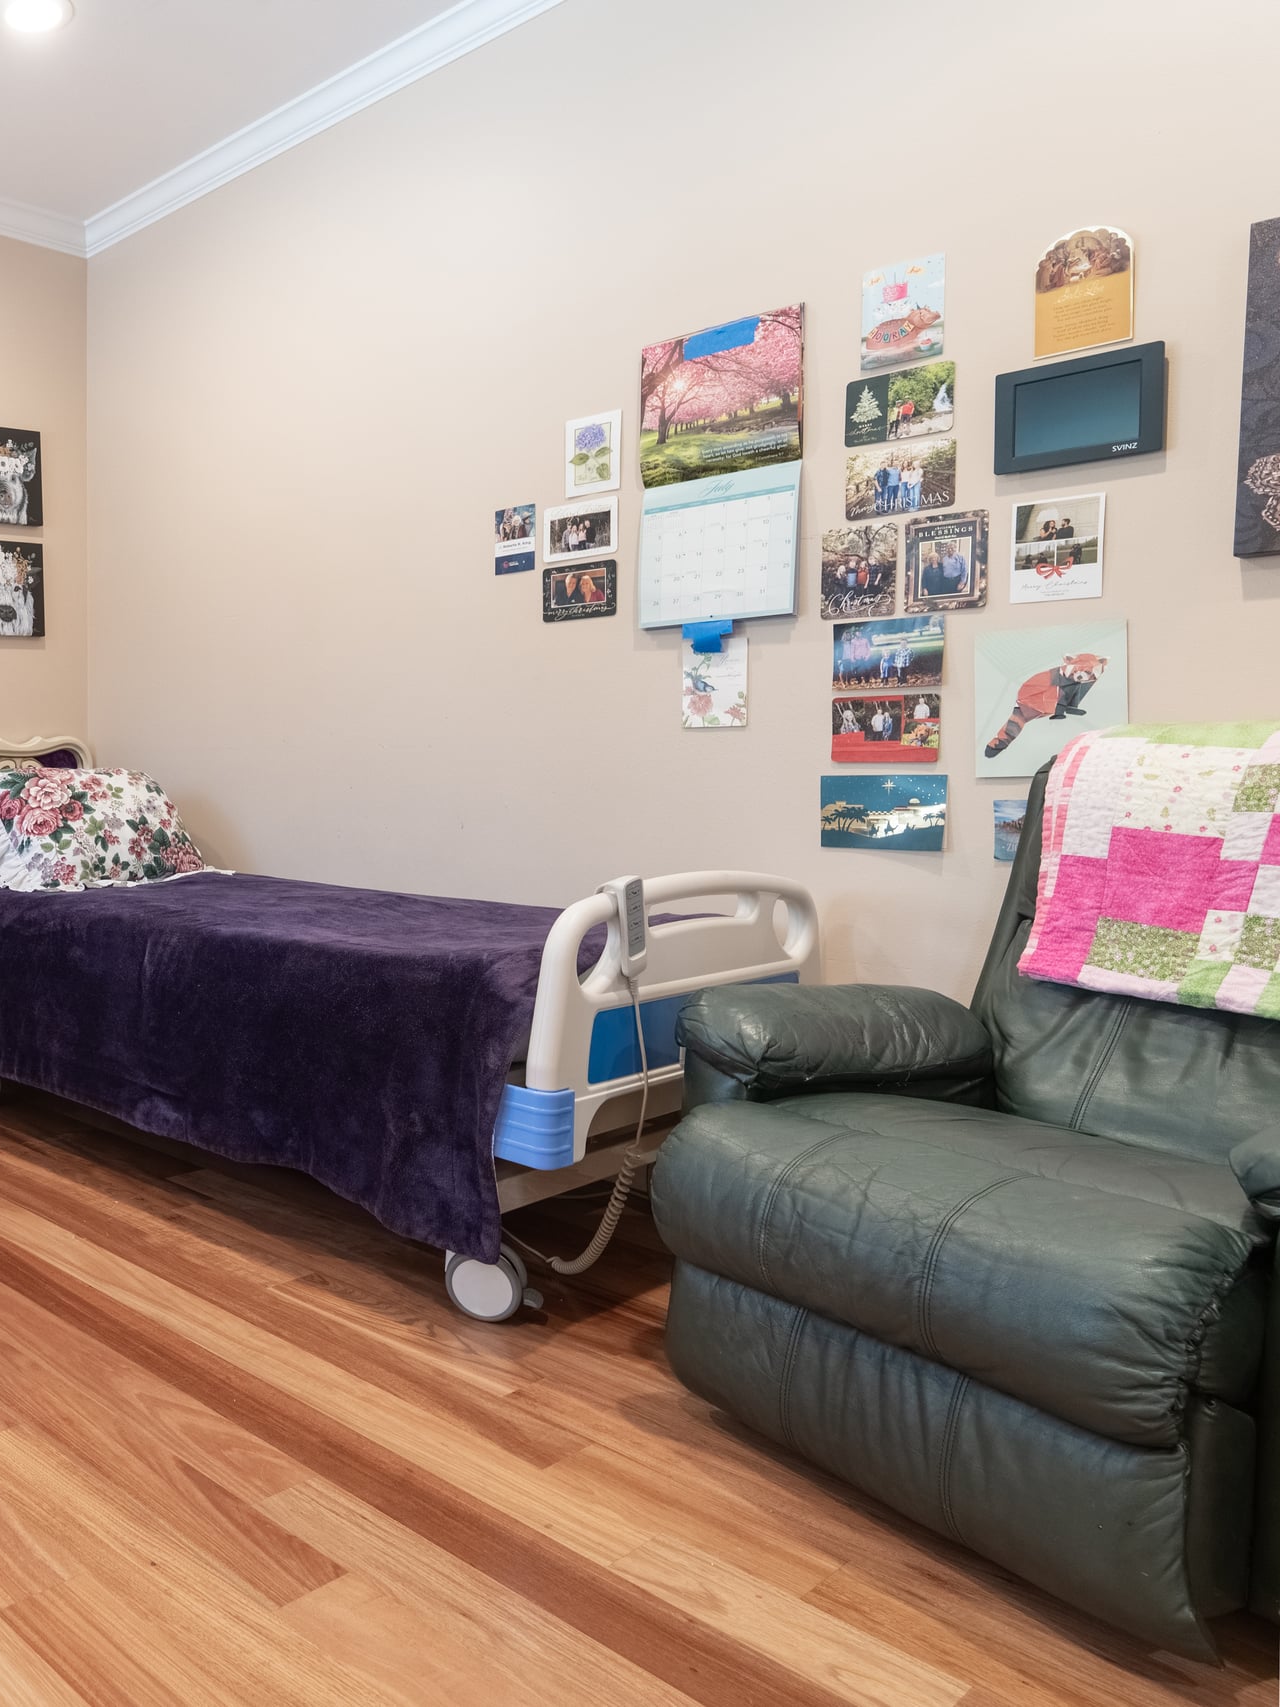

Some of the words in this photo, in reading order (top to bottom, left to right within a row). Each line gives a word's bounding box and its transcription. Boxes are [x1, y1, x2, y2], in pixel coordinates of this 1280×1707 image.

[1112, 442, 1138, 452] SVINZ
[700, 479, 736, 498] July
[874, 491, 950, 512] CHRISTMAS
[919, 526, 973, 538] BLESSINGS
